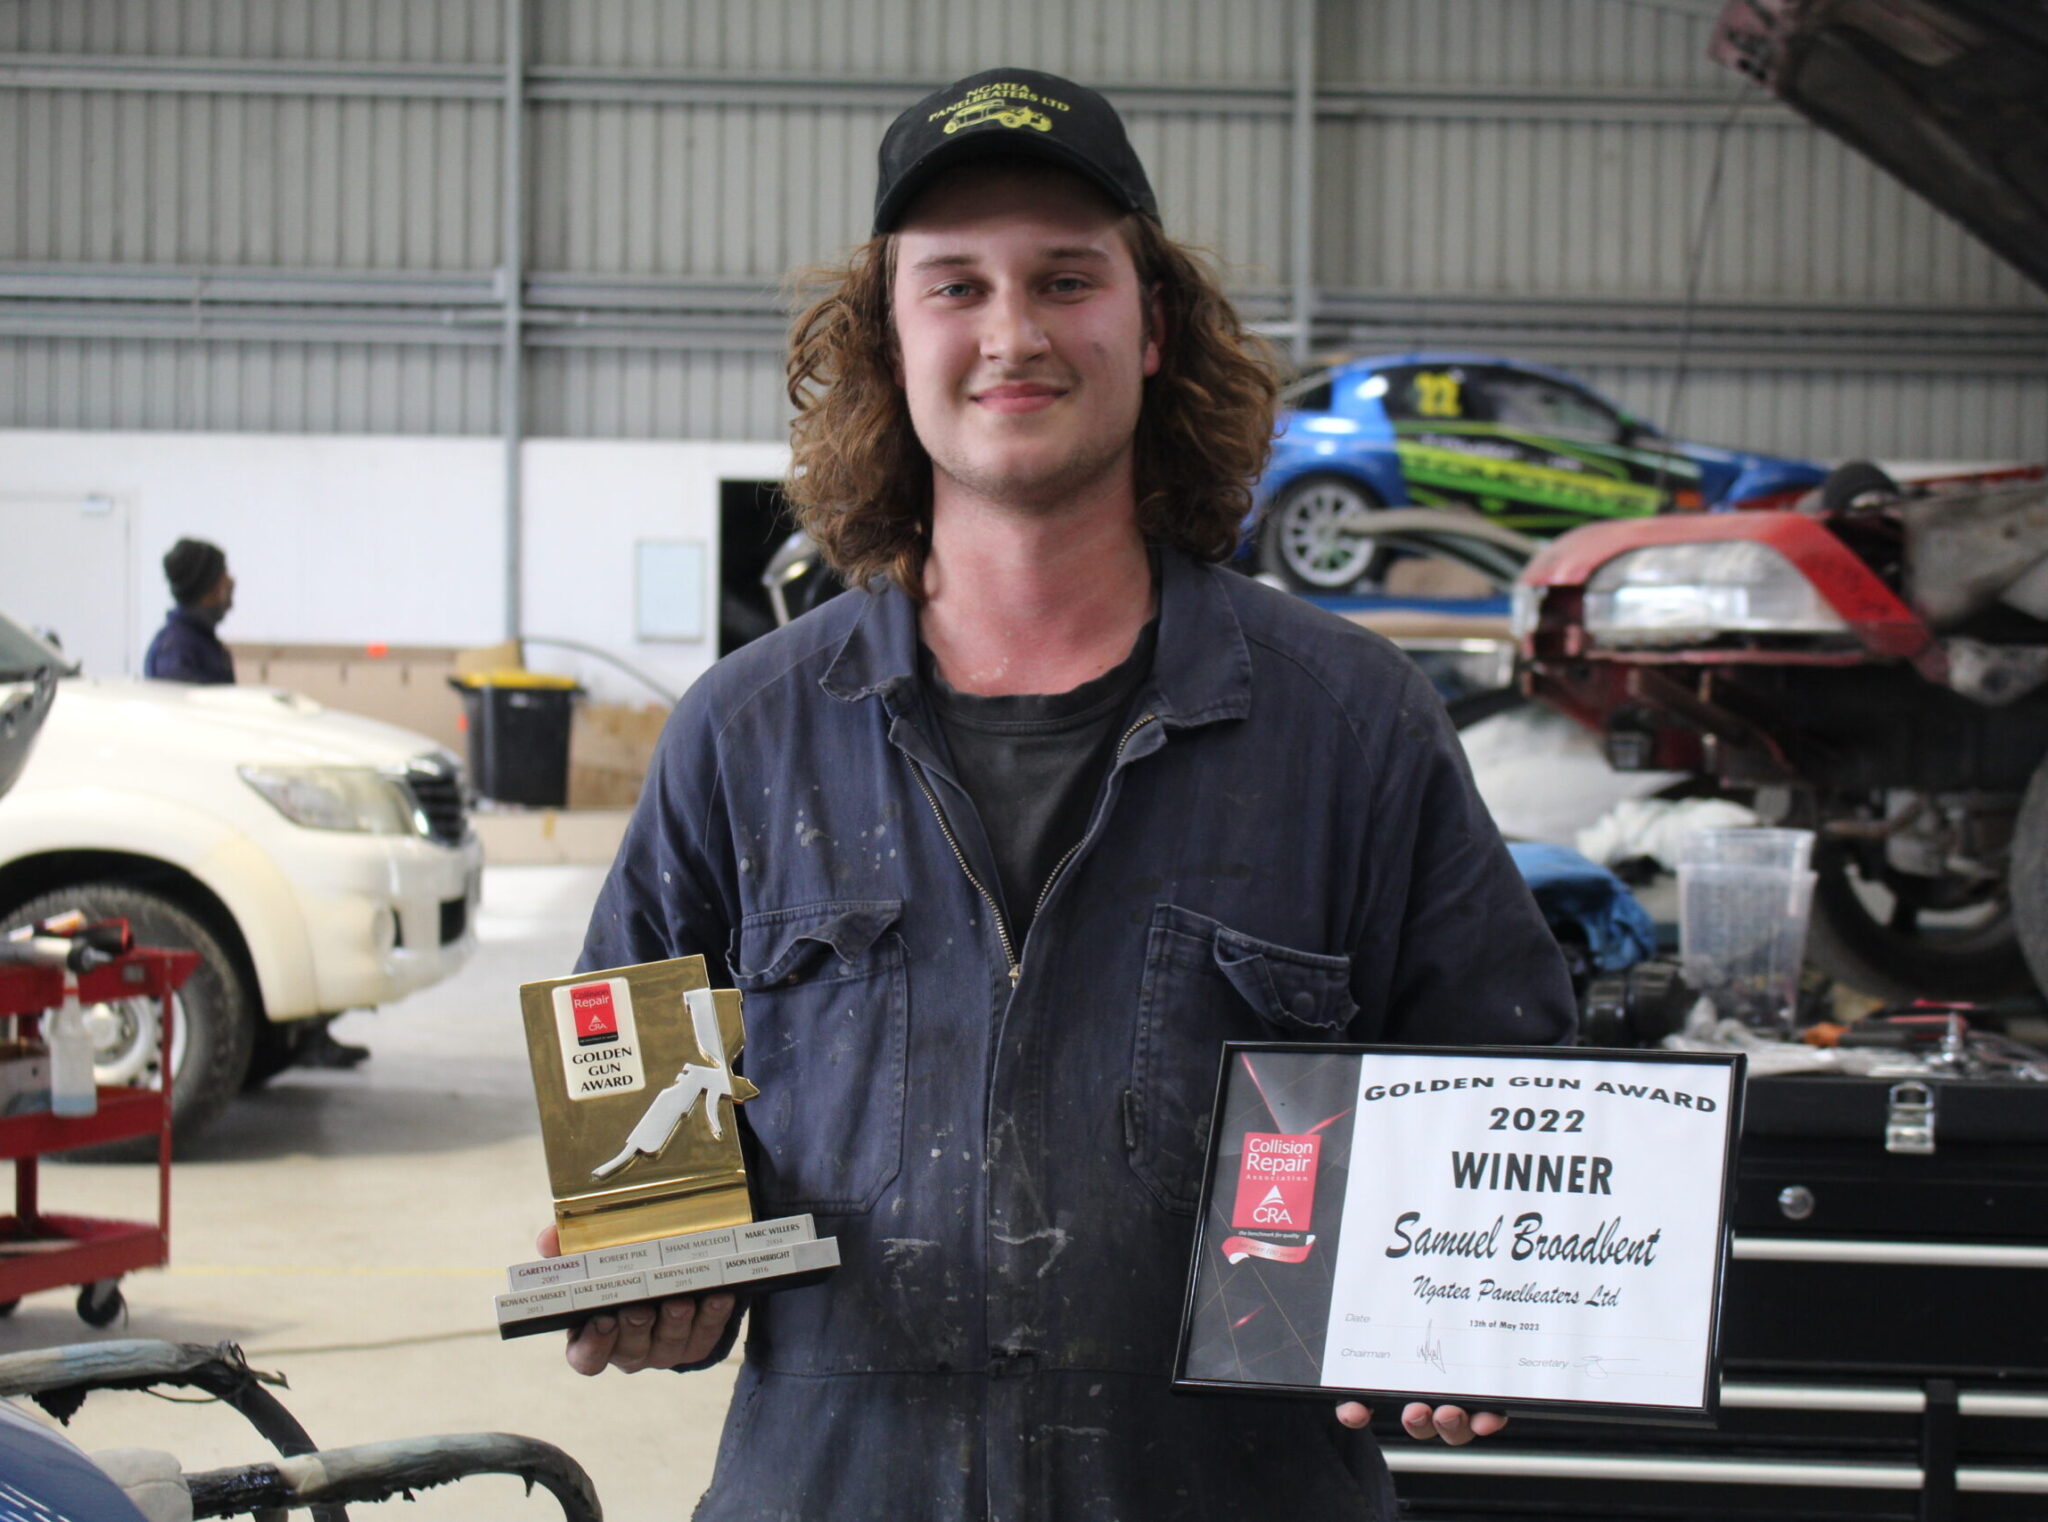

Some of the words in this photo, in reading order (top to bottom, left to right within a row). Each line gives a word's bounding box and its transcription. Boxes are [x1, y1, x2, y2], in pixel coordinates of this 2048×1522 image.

[966, 82, 1030, 98] NGATEA
[928, 90, 1039, 122] PANELBEATERS
[1041, 96, 1071, 112] LTD
[573, 996, 610, 1009] Repair
[588, 1023, 608, 1032] CRA
[572, 1046, 632, 1065] GOLDEN
[588, 1062, 621, 1076] GUN
[581, 1075, 633, 1092] AWARD
[1364, 1076, 1495, 1102] GOLDEN
[1509, 1076, 1581, 1090] GUN
[1594, 1081, 1717, 1114] AWARD
[1489, 1107, 1586, 1133] 2022
[1249, 1138, 1313, 1155] Collision
[1246, 1153, 1311, 1175] Repair
[1451, 1151, 1613, 1196] WINNER
[1253, 1207, 1293, 1225] CRA
[744, 1230, 767, 1240] MARC
[769, 1223, 800, 1236] WILLERS
[1385, 1211, 1504, 1259] Samuel
[1510, 1211, 1662, 1267] Broadbent
[665, 1243, 691, 1254] SHANE
[692, 1235, 731, 1249] MACLEOD
[599, 1253, 629, 1265] ROBERT
[630, 1249, 648, 1260] PIKE
[725, 1258, 747, 1270] JASON
[748, 1250, 790, 1265] HELMBRIGHT
[518, 1266, 552, 1278] GARETH
[553, 1260, 580, 1272] OAKES
[654, 1268, 684, 1281] KERRYN
[685, 1263, 710, 1275] HORN
[751, 1266, 769, 1276] 2016
[574, 1283, 593, 1295] LUKE
[595, 1276, 642, 1292] TAHURANGI
[1412, 1275, 1471, 1305] Ngatea
[1477, 1278, 1580, 1306] Panelbeaters
[1584, 1284, 1622, 1308] Ltd
[500, 1296, 529, 1309] ROWAN
[530, 1290, 567, 1303] CUMISKEY
[601, 1292, 618, 1302] 2014
[1345, 1312, 1371, 1324] Date
[1469, 1319, 1487, 1329] 13th
[1488, 1320, 1497, 1329] of
[1499, 1321, 1517, 1332] May
[1341, 1347, 1391, 1360] Chairman
[1518, 1356, 1570, 1370] Secretary
